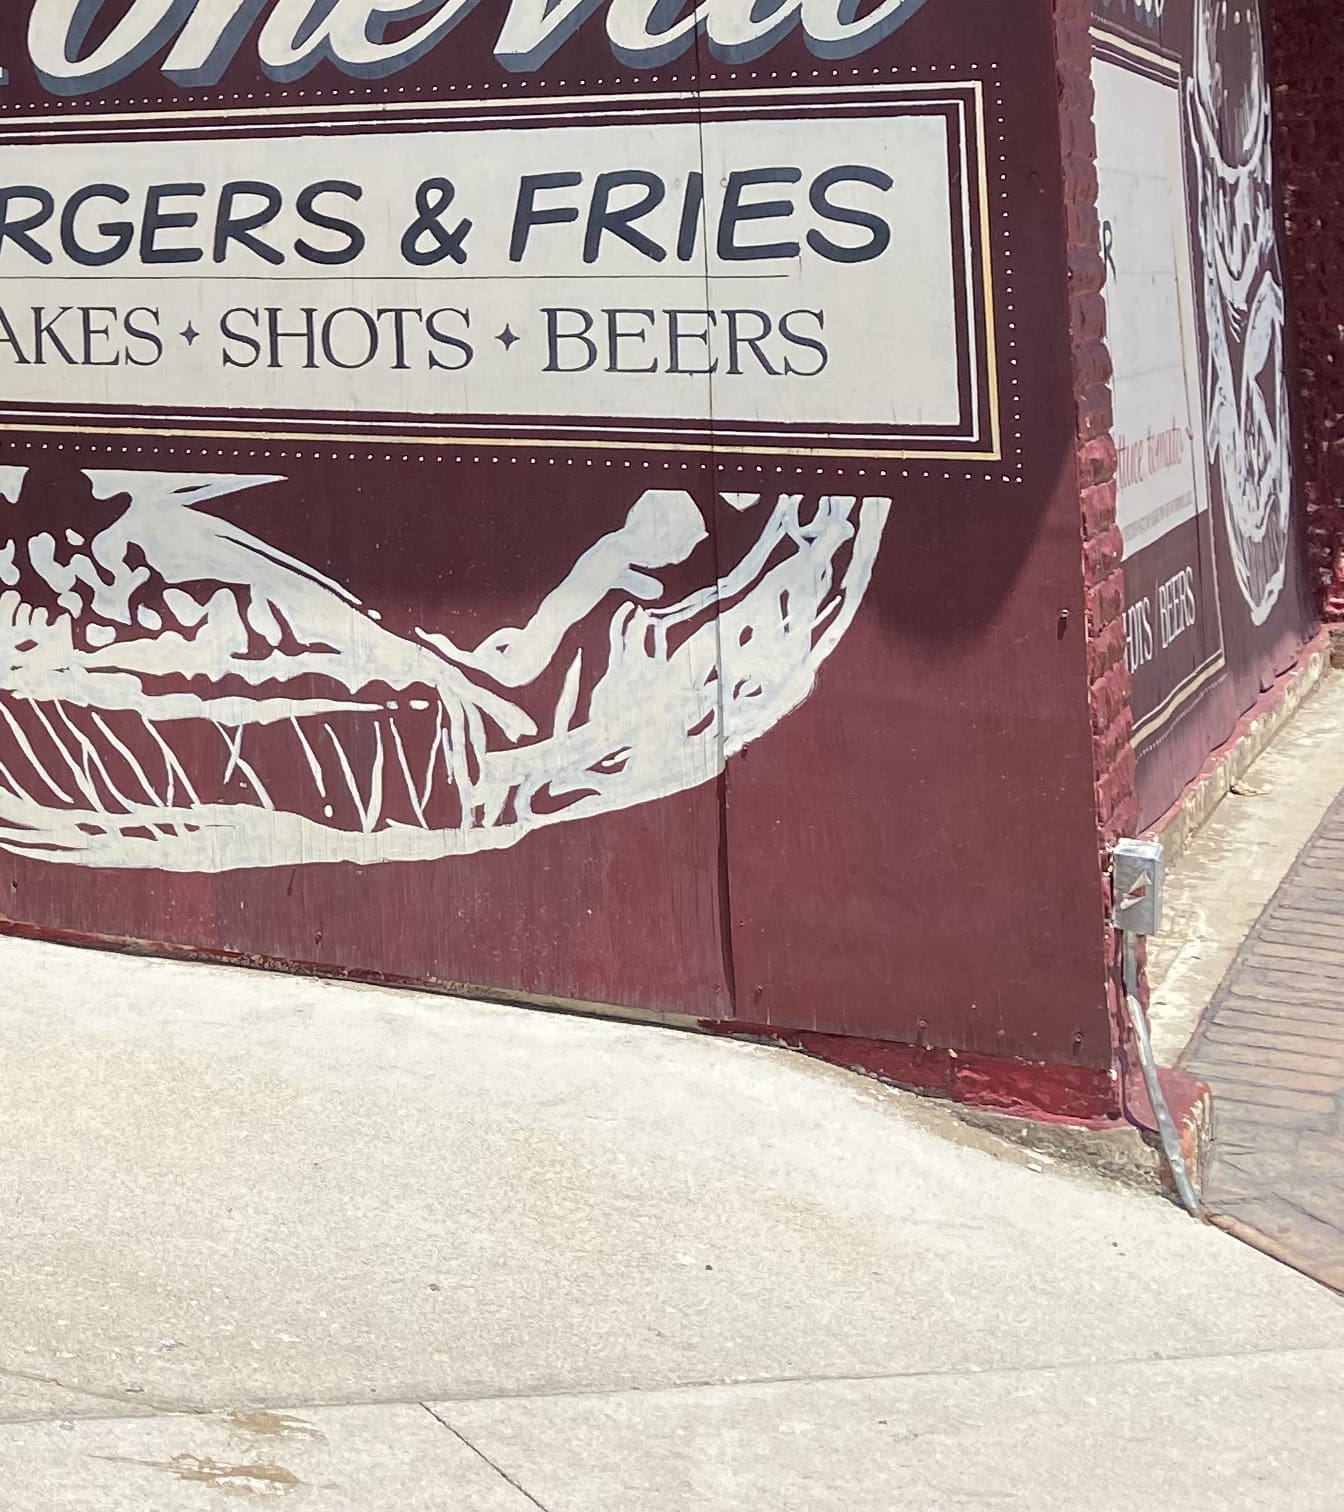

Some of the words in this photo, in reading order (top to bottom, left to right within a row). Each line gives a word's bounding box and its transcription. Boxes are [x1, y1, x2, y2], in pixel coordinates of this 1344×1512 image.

[401, 176, 473, 267] &
[507, 164, 892, 265] FRIES
[221, 306, 474, 370] SHOTS
[539, 308, 829, 377] BEERS
[1122, 596, 1153, 675] HOTS
[1158, 566, 1196, 649] BEERS
